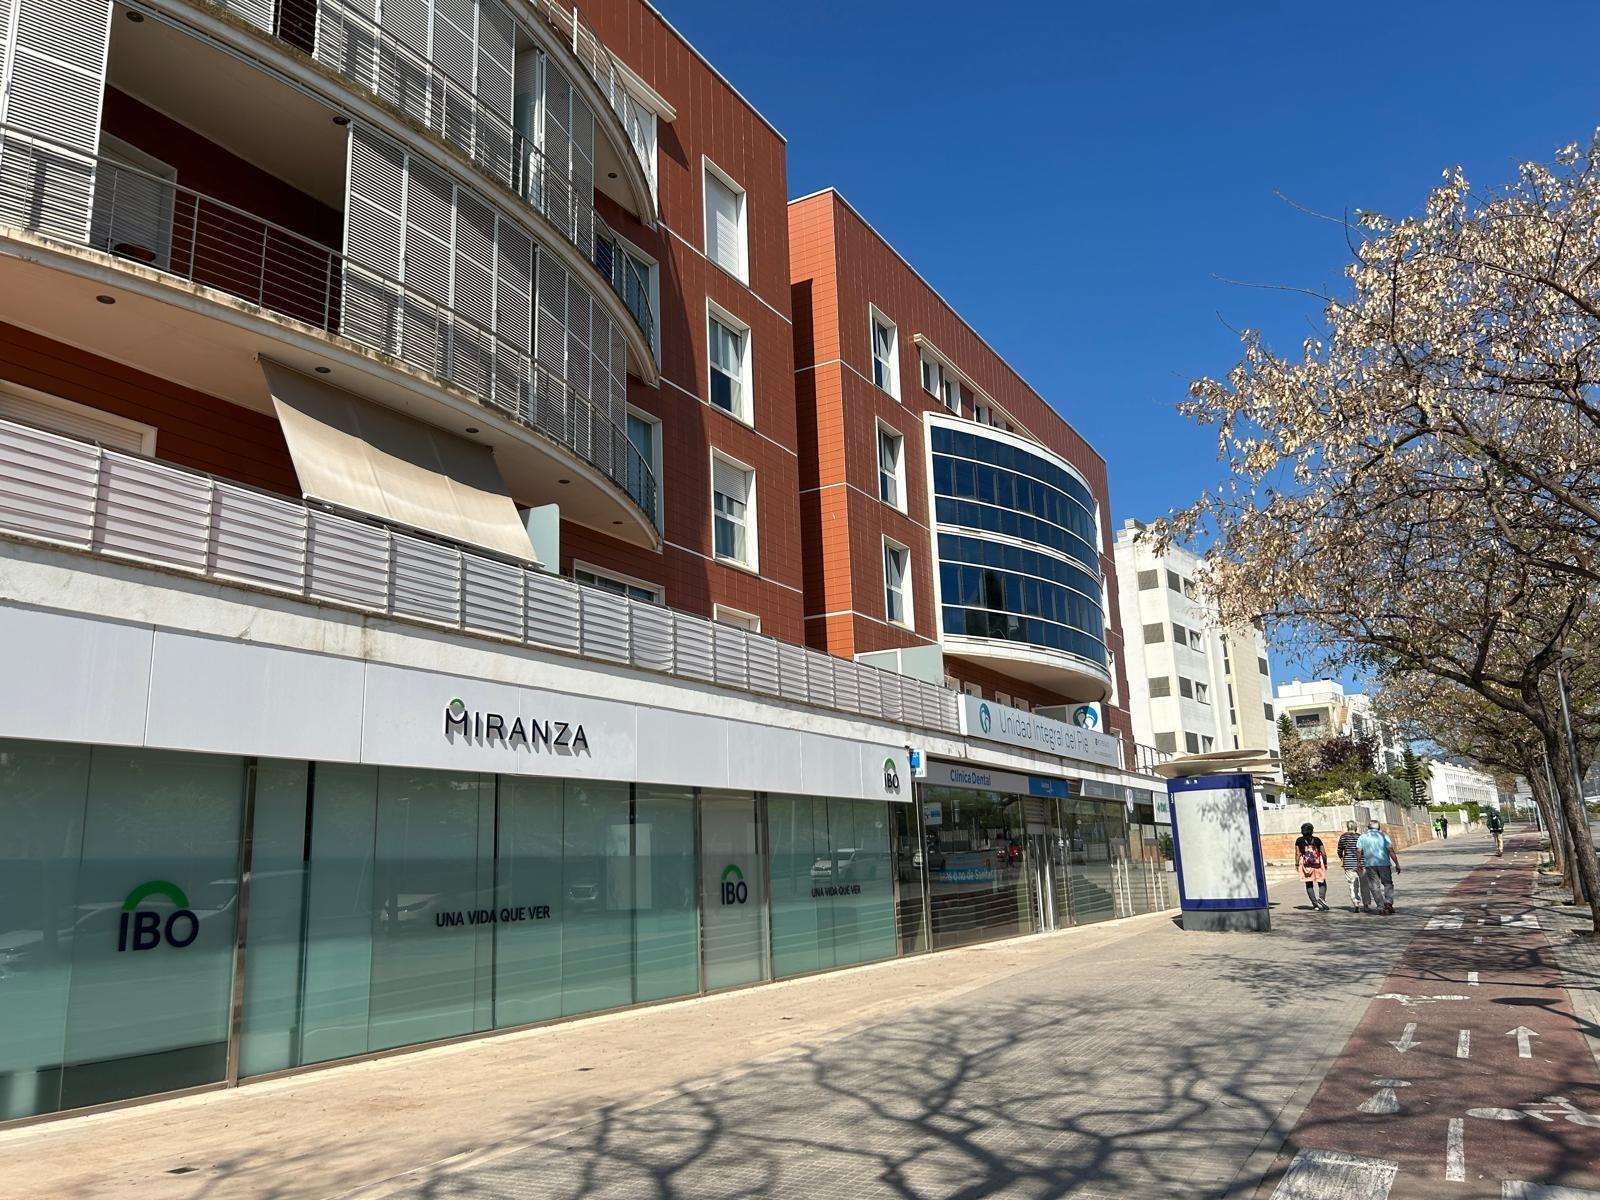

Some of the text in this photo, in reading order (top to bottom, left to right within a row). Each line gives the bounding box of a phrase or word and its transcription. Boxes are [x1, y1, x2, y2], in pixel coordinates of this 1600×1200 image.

[444, 706, 589, 749] MIRANZA
[998, 708, 1089, 754] Unidad Integral del Pie
[883, 772, 900, 789] IBO
[972, 772, 992, 786] Dental
[720, 881, 748, 906] IBO
[811, 884, 861, 898] UNA VIDA QUE VER
[435, 904, 551, 927] UNA VIDA QUE VER
[117, 909, 200, 953] IBO
